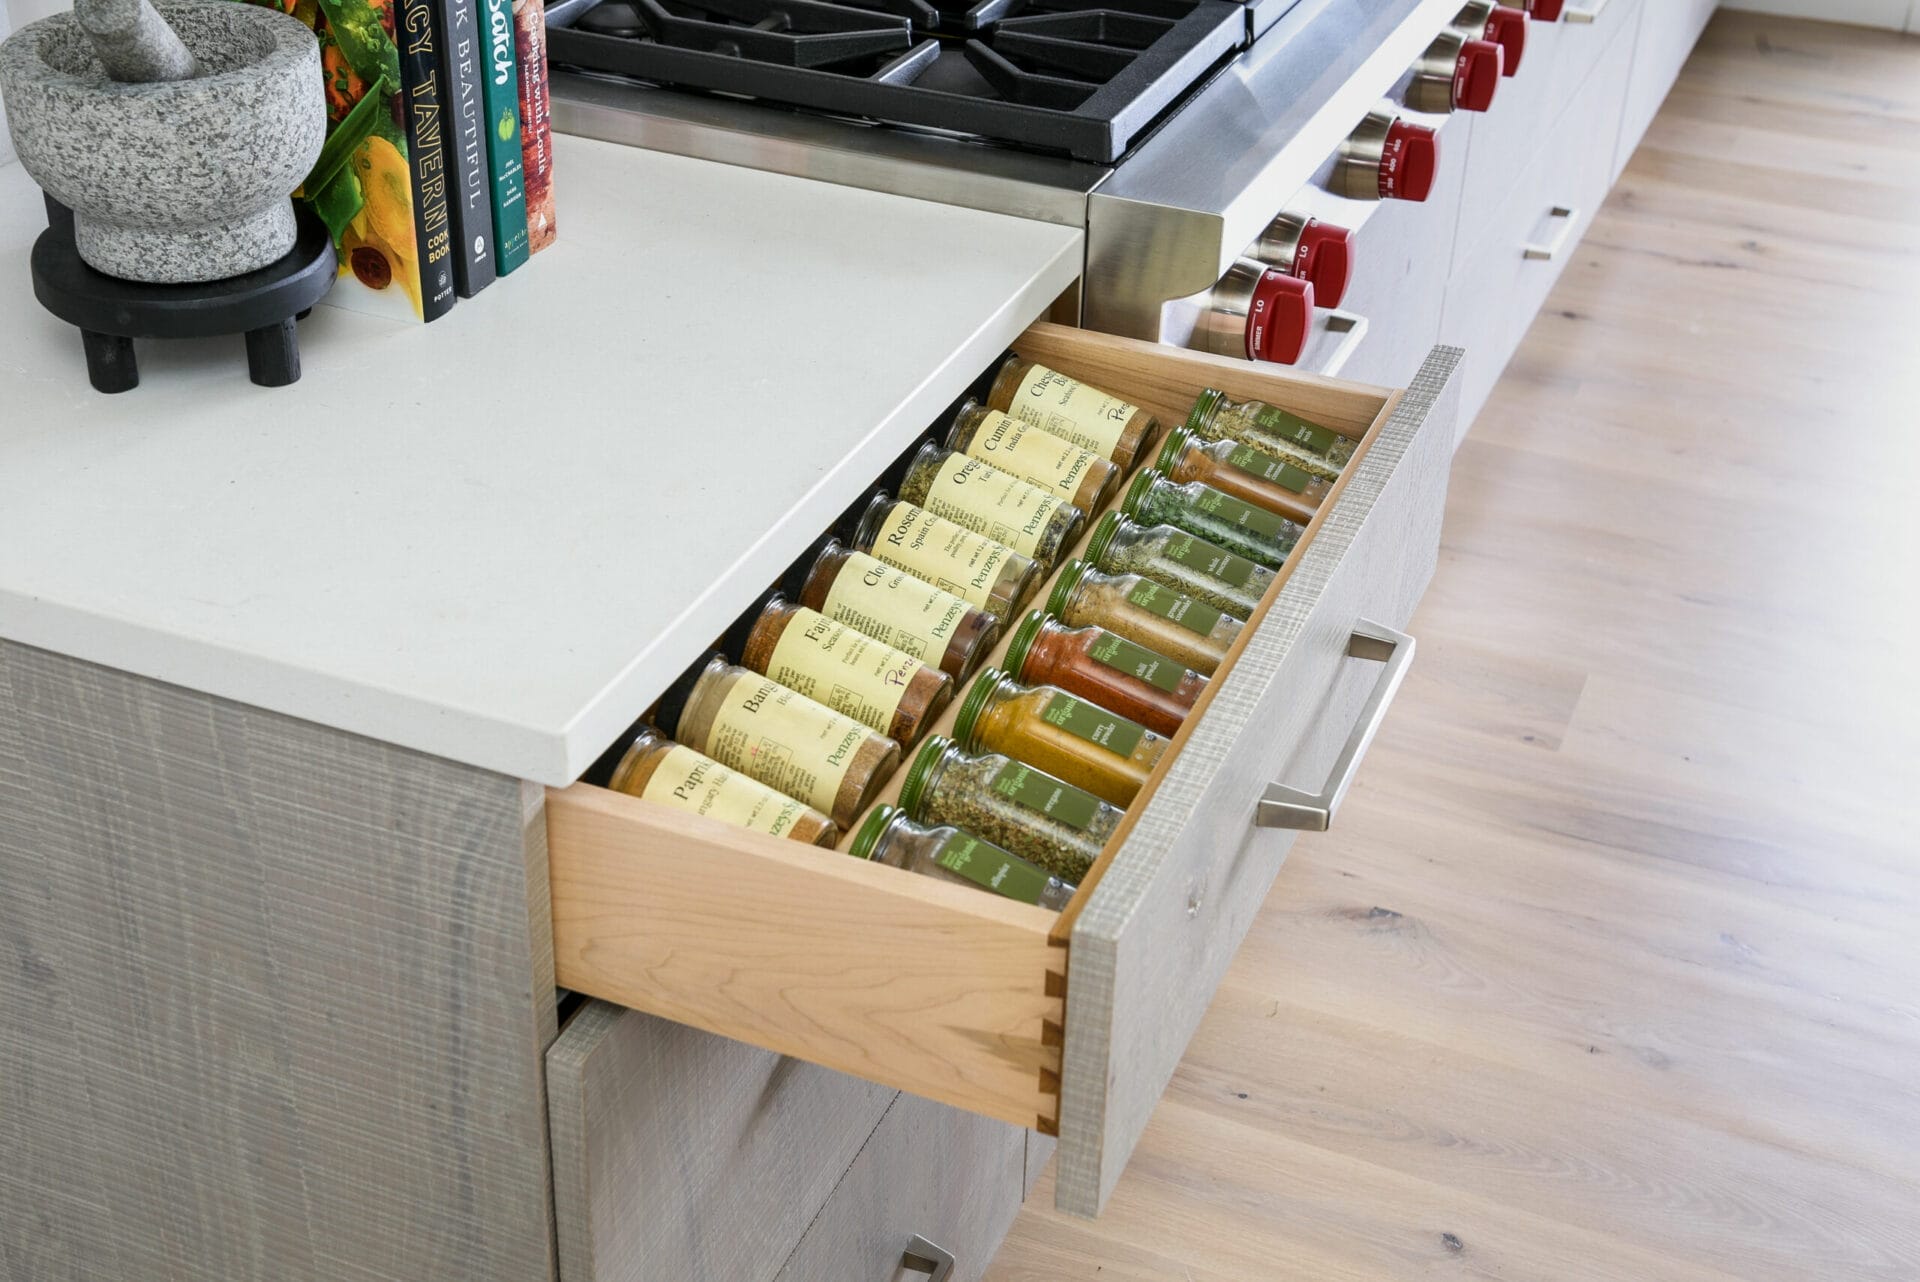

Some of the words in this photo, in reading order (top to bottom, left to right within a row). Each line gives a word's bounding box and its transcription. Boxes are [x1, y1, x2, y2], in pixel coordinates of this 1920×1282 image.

[529, 12, 541, 84] Cooking
[533, 84, 544, 125] with
[457, 38, 483, 209] BEAUTIFUL
[413, 70, 448, 232] TAVERN
[536, 126, 546, 176] Loula
[1389, 158, 1397, 173] 400
[428, 229, 449, 249] COOK
[428, 243, 450, 264] BOOK
[1299, 245, 1308, 258] LO
[434, 286, 453, 302] POTTER
[1256, 300, 1264, 313] LO
[984, 419, 1012, 451] Cumin
[1005, 431, 1021, 452] India
[1059, 451, 1088, 490] Penzeys
[1022, 499, 1051, 537] Penzeys
[910, 528, 927, 550] Spain
[971, 551, 1001, 590] Penzeys
[931, 602, 961, 639] Penzeys
[1144, 660, 1160, 681] powder
[1055, 698, 1078, 727] organic
[827, 725, 861, 768] Penzeys
[1099, 722, 1116, 746] powder
[1006, 767, 1030, 797] organic
[1044, 787, 1063, 812] oregano
[952, 840, 979, 871] organic
